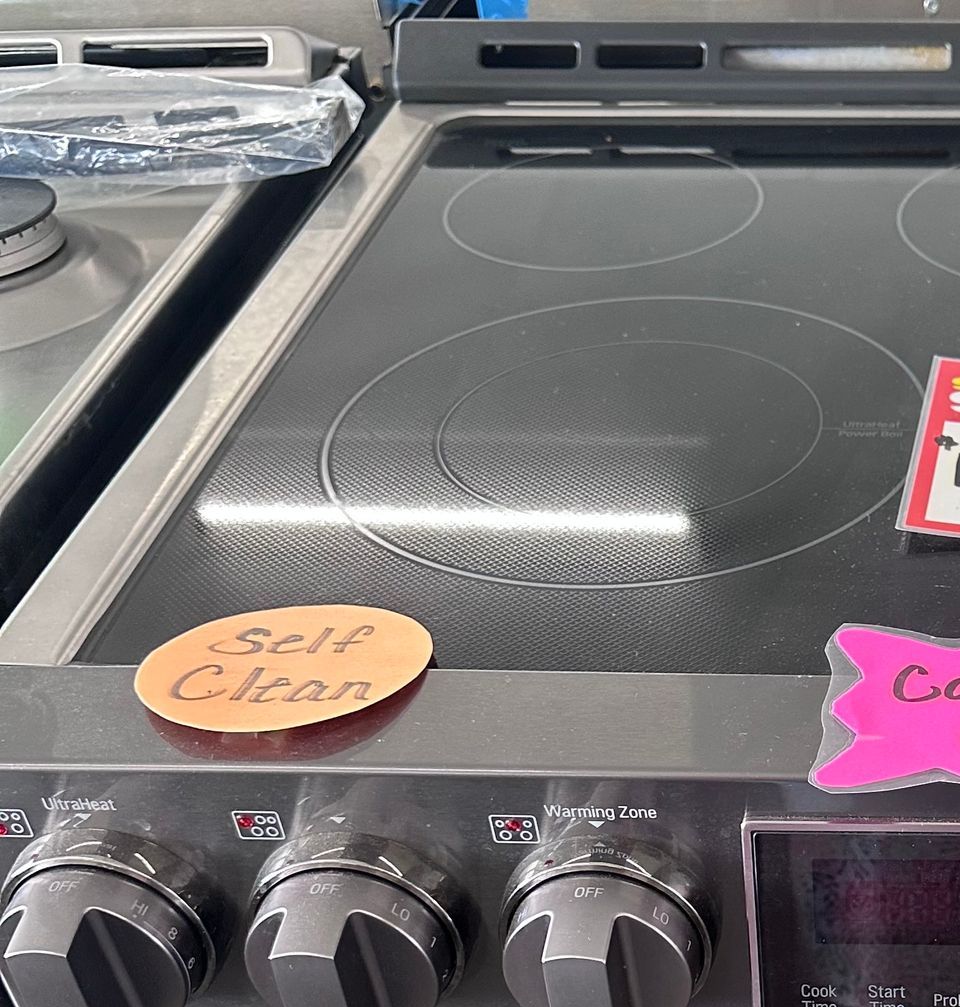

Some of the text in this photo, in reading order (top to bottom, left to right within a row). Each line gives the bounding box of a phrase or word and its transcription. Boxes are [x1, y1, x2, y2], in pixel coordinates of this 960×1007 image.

[207, 625, 374, 655] Self
[168, 664, 372, 703] Clean
[41, 797, 117, 812] UltraHeat
[543, 804, 658, 821] Warming Zone
[49, 880, 80, 892] OFF
[309, 883, 340, 895] OFF
[574, 886, 604, 898] OFF
[131, 899, 149, 916] HI
[391, 903, 411, 921] LO
[652, 906, 670, 925] LO
[167, 926, 179, 940] 8
[430, 936, 437, 948] 1
[801, 984, 837, 998] Cook
[868, 984, 906, 999] Start
